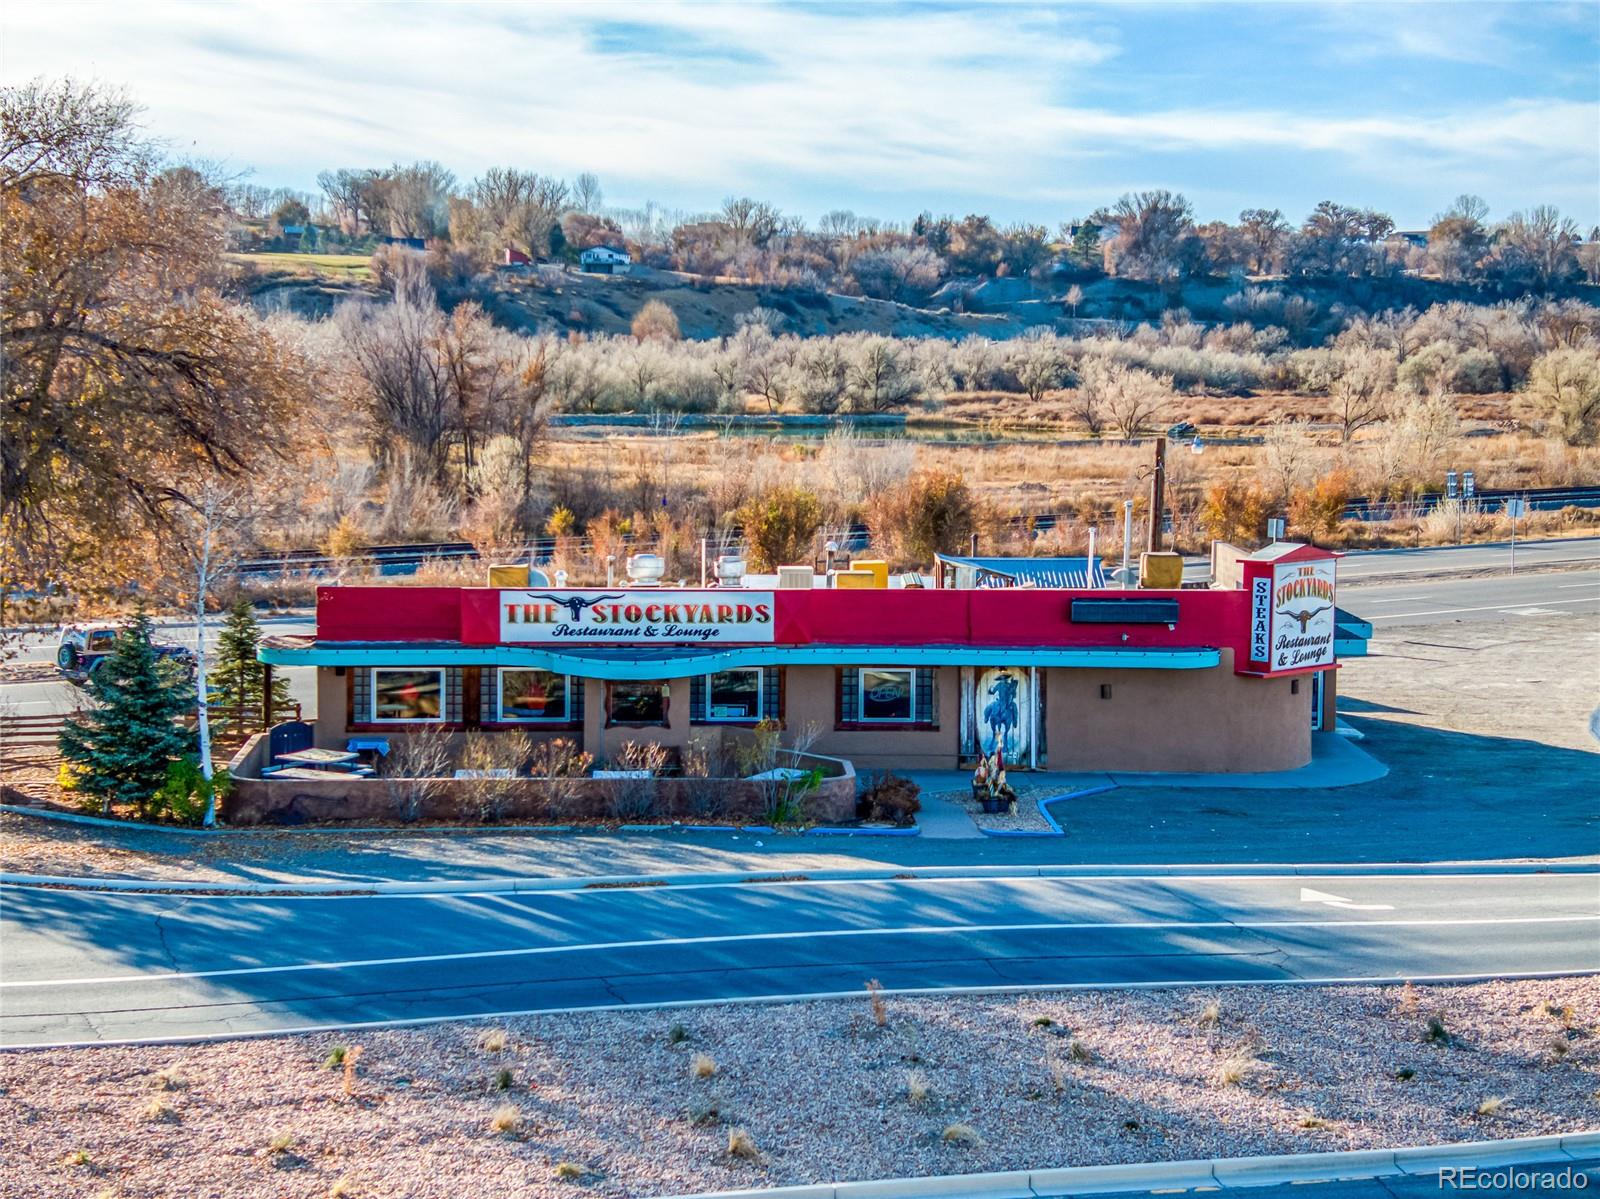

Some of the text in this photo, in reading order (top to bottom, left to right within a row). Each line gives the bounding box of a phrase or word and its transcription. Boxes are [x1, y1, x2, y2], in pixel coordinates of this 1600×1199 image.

[1297, 566, 1314, 576] THE
[1276, 578, 1333, 608] STOCKYARDS
[504, 603, 771, 624] THE STOCKYARDS
[1255, 582, 1267, 657] STEAKS
[552, 624, 720, 640] Restaurant & Lounge
[1275, 633, 1331, 650] Restaurant
[1277, 646, 1327, 667] & Lounge
